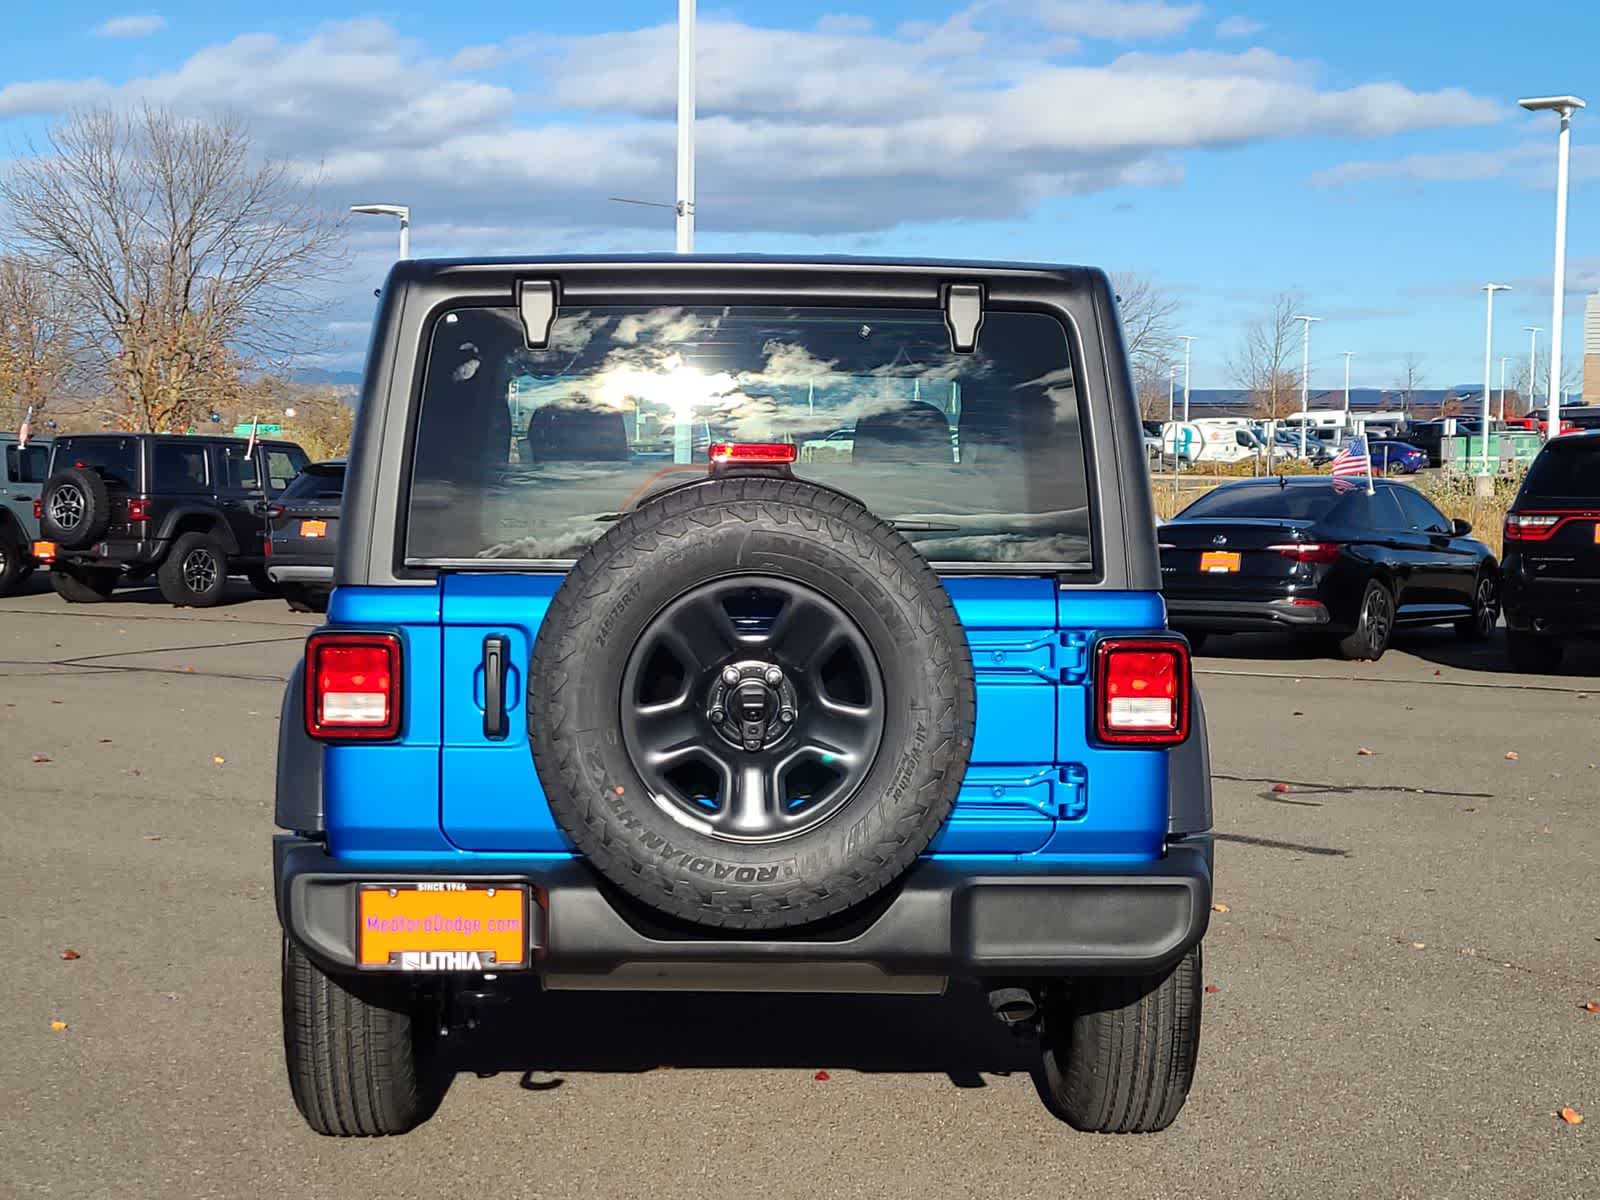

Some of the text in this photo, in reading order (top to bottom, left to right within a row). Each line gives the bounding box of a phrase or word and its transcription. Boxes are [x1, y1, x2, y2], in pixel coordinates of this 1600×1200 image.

[639, 831, 779, 883] ROADIAN
[417, 883, 443, 892] SINCE
[367, 915, 520, 936] MedfordDodgecom
[422, 952, 482, 970] LITHIA
